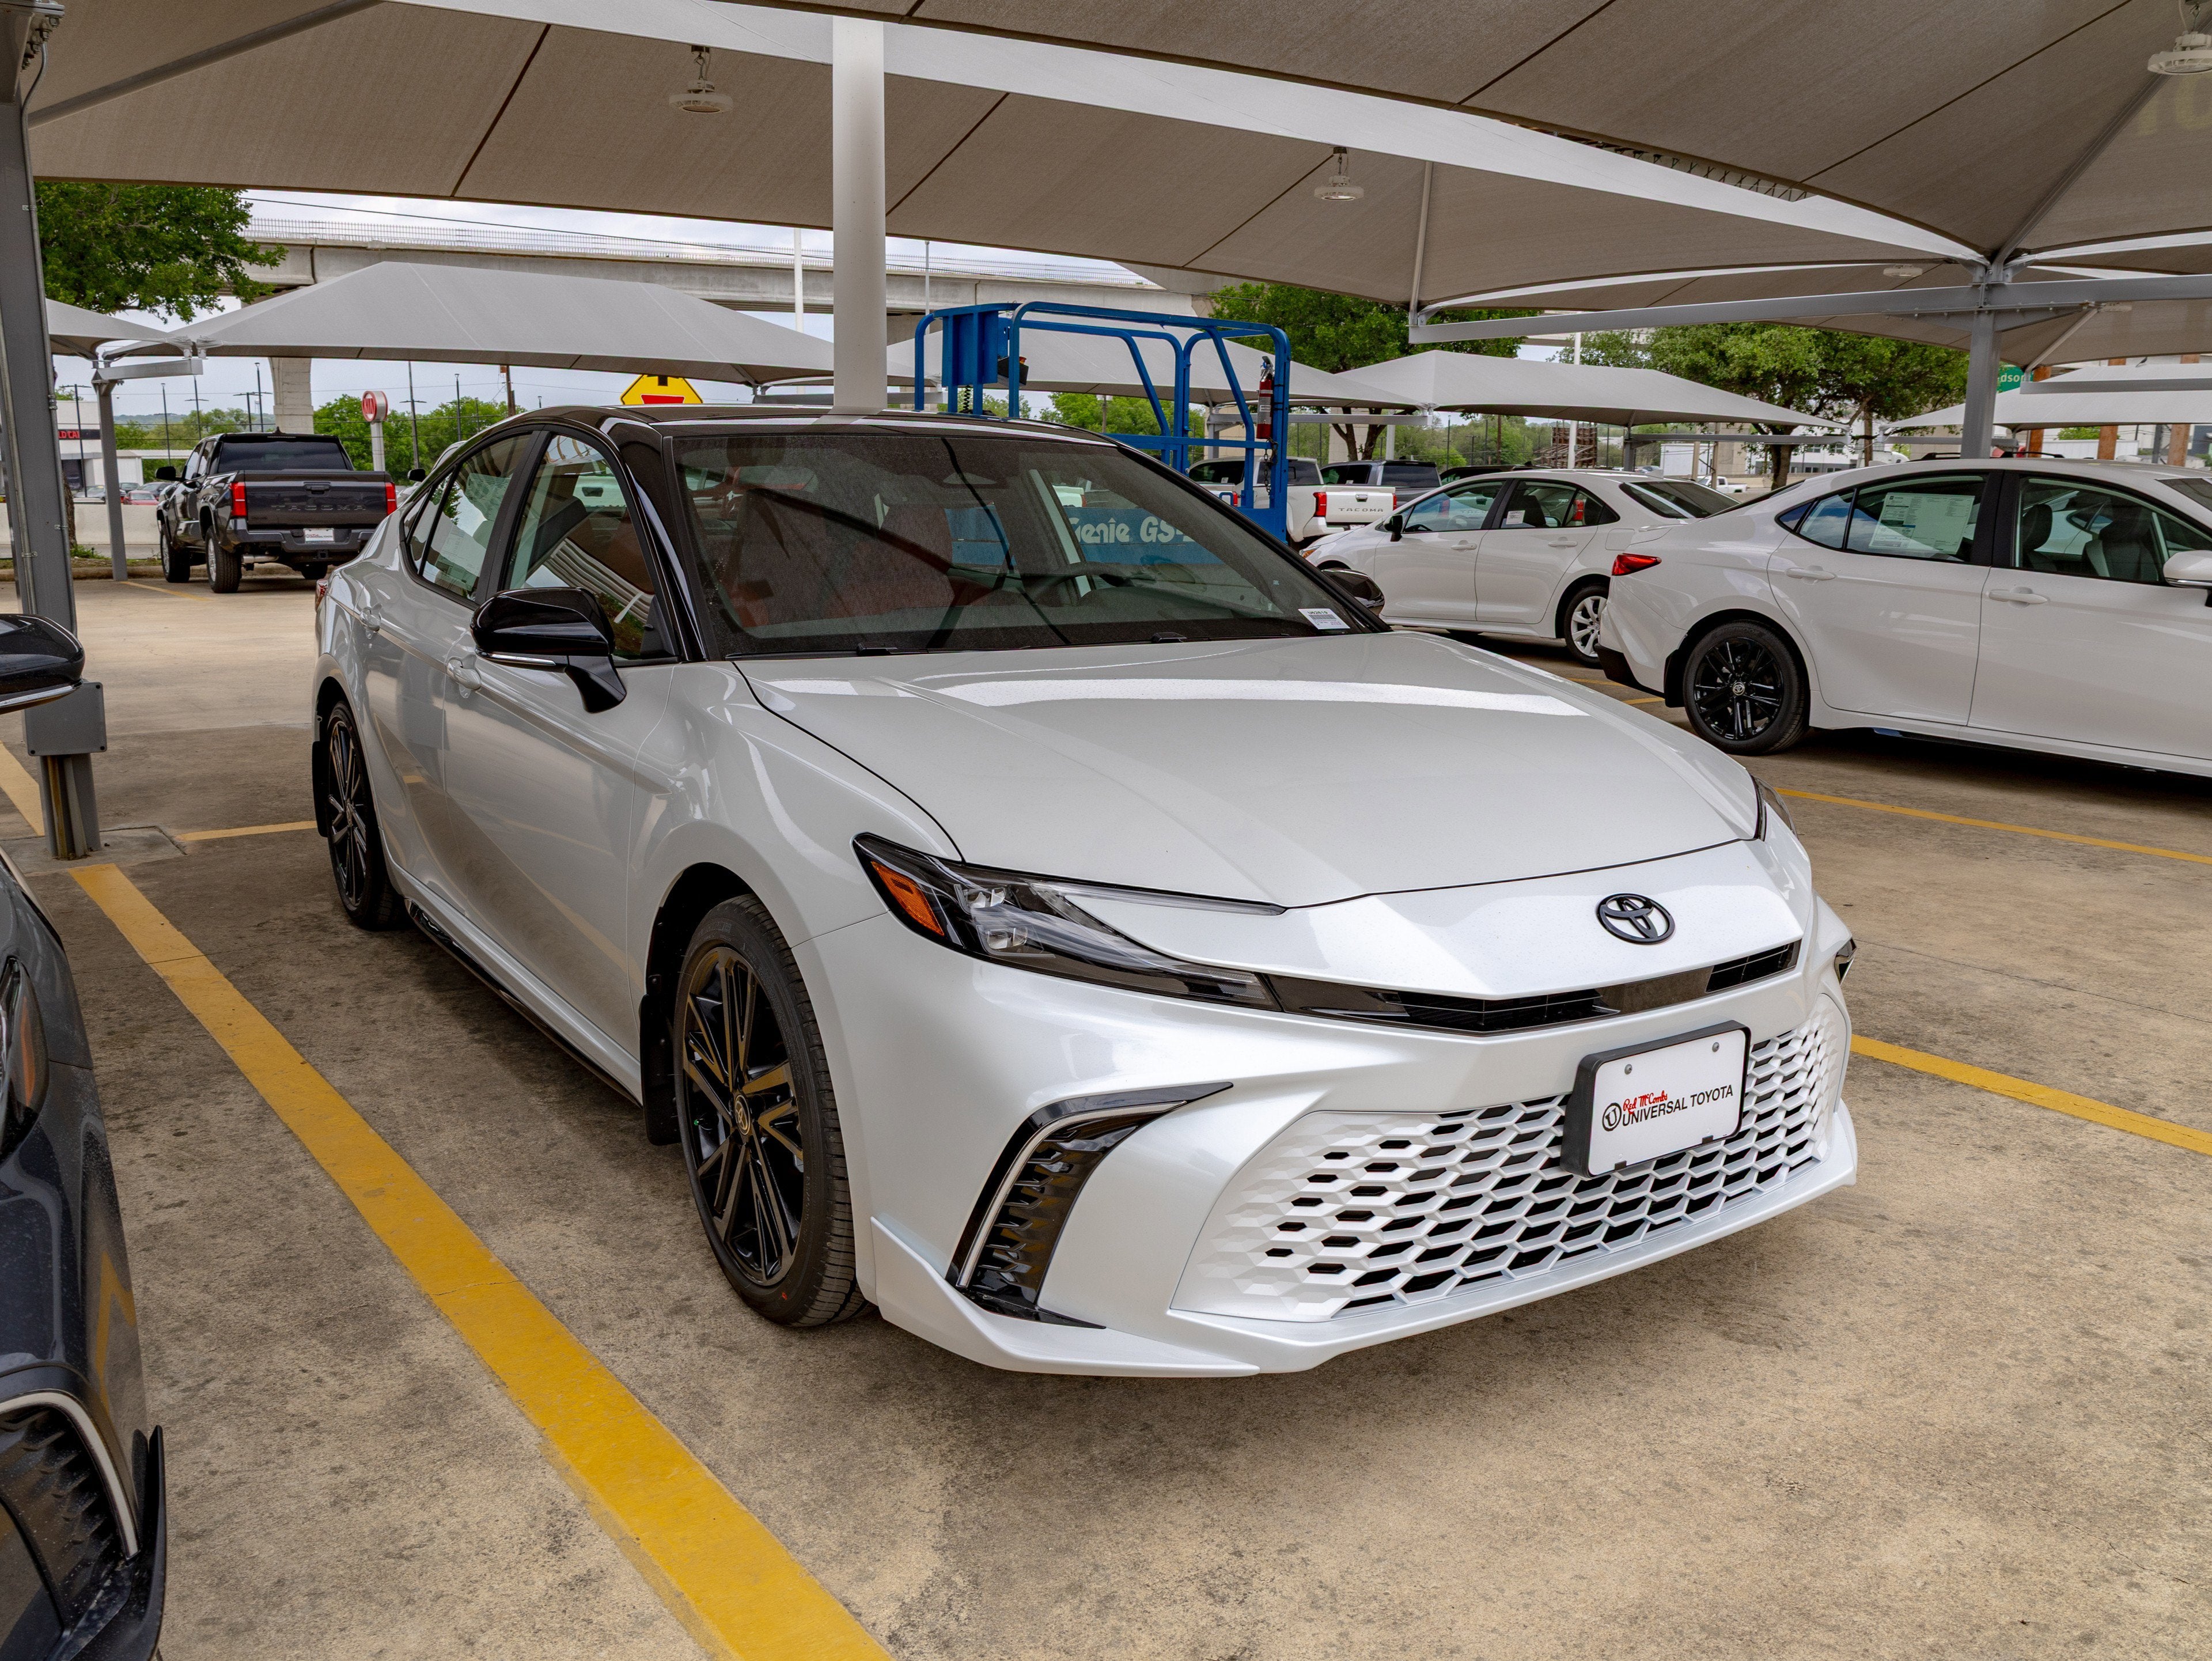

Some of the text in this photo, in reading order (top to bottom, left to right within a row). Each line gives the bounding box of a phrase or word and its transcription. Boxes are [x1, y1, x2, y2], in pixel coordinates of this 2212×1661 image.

[1622, 1084, 1733, 1127] UNIVERSAL TOYOTA
[1623, 1090, 1668, 1114] Red McCombs
